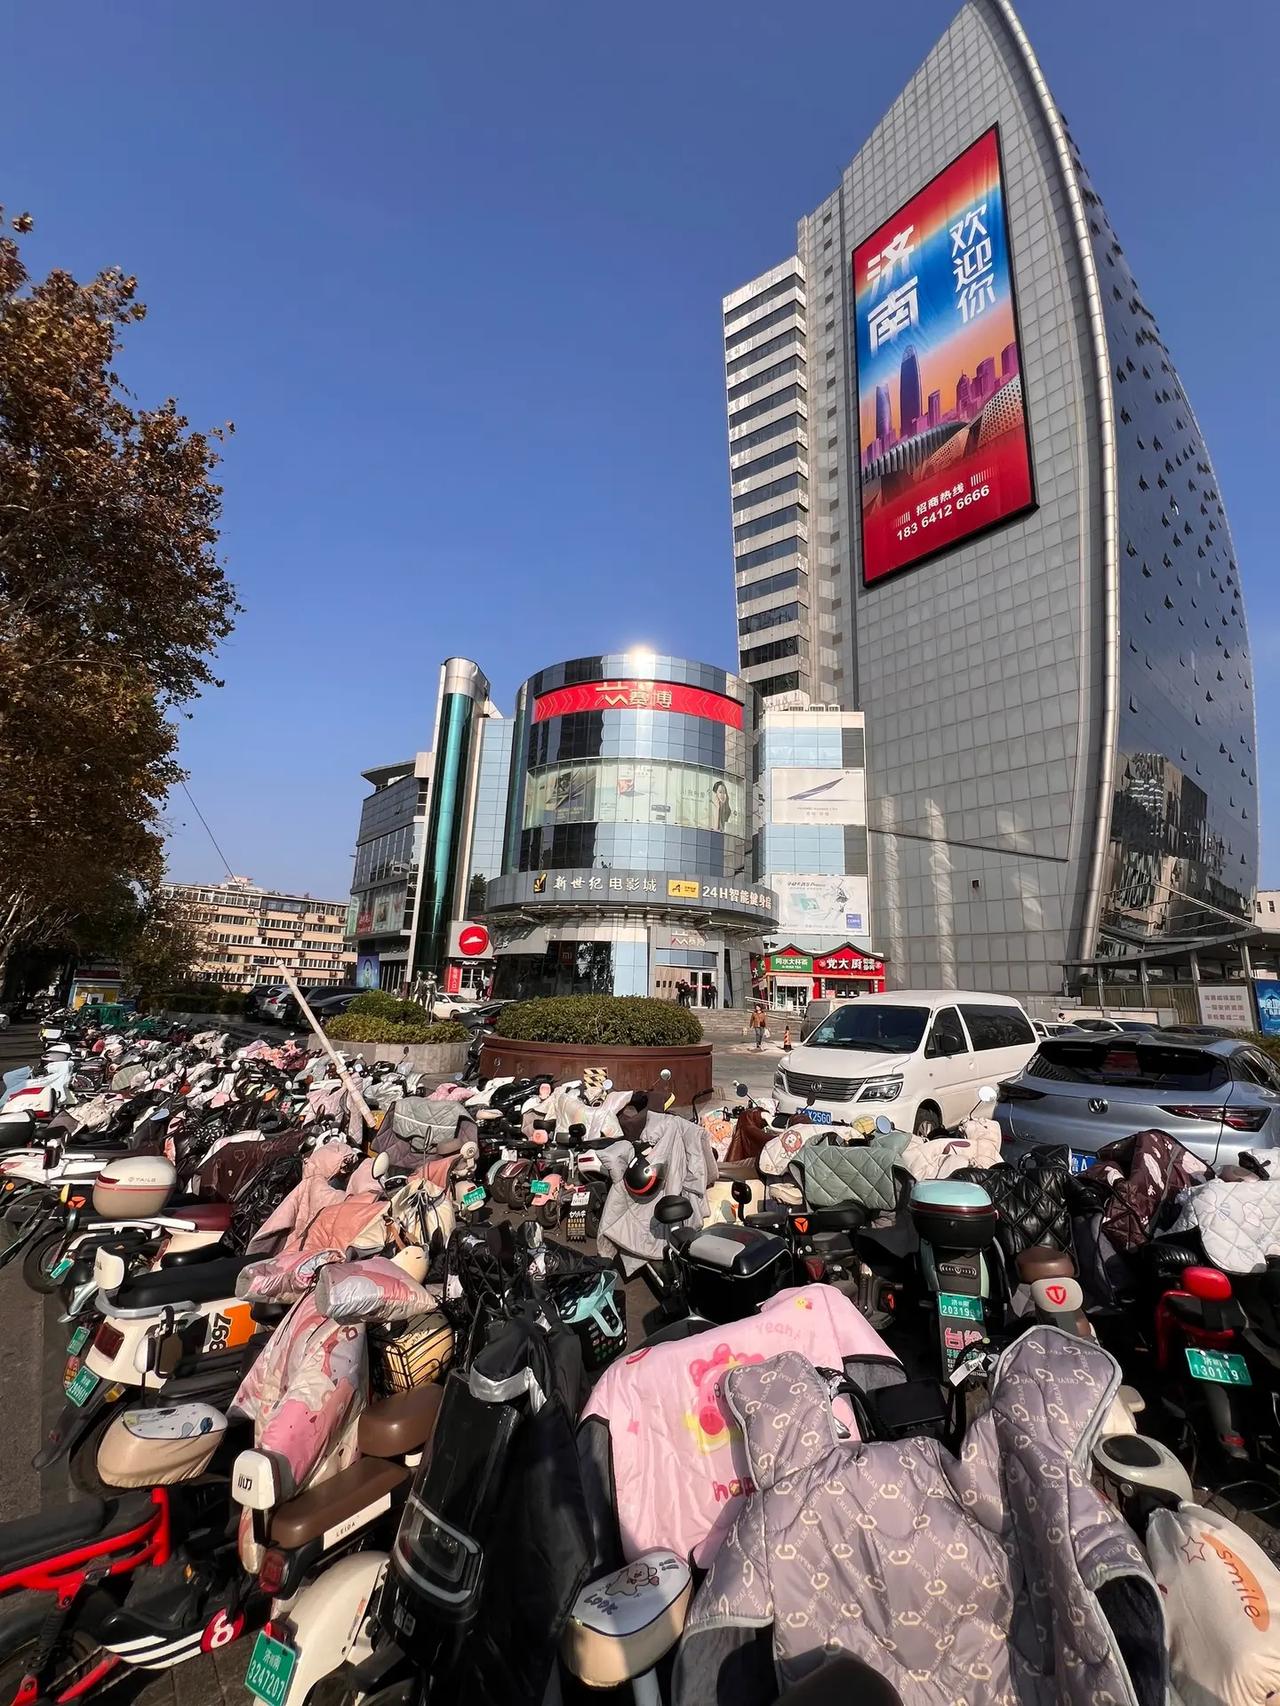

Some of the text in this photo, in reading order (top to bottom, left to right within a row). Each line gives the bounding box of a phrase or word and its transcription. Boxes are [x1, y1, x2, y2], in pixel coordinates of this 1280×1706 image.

[866, 224, 919, 352] 济南
[949, 203, 996, 324] 欢迎你
[896, 484, 990, 541] 183 6412 6666
[916, 482, 966, 516] 招商热线
[553, 875, 658, 893] 新世纪电影城
[1216, 1550, 1260, 1619] smile
